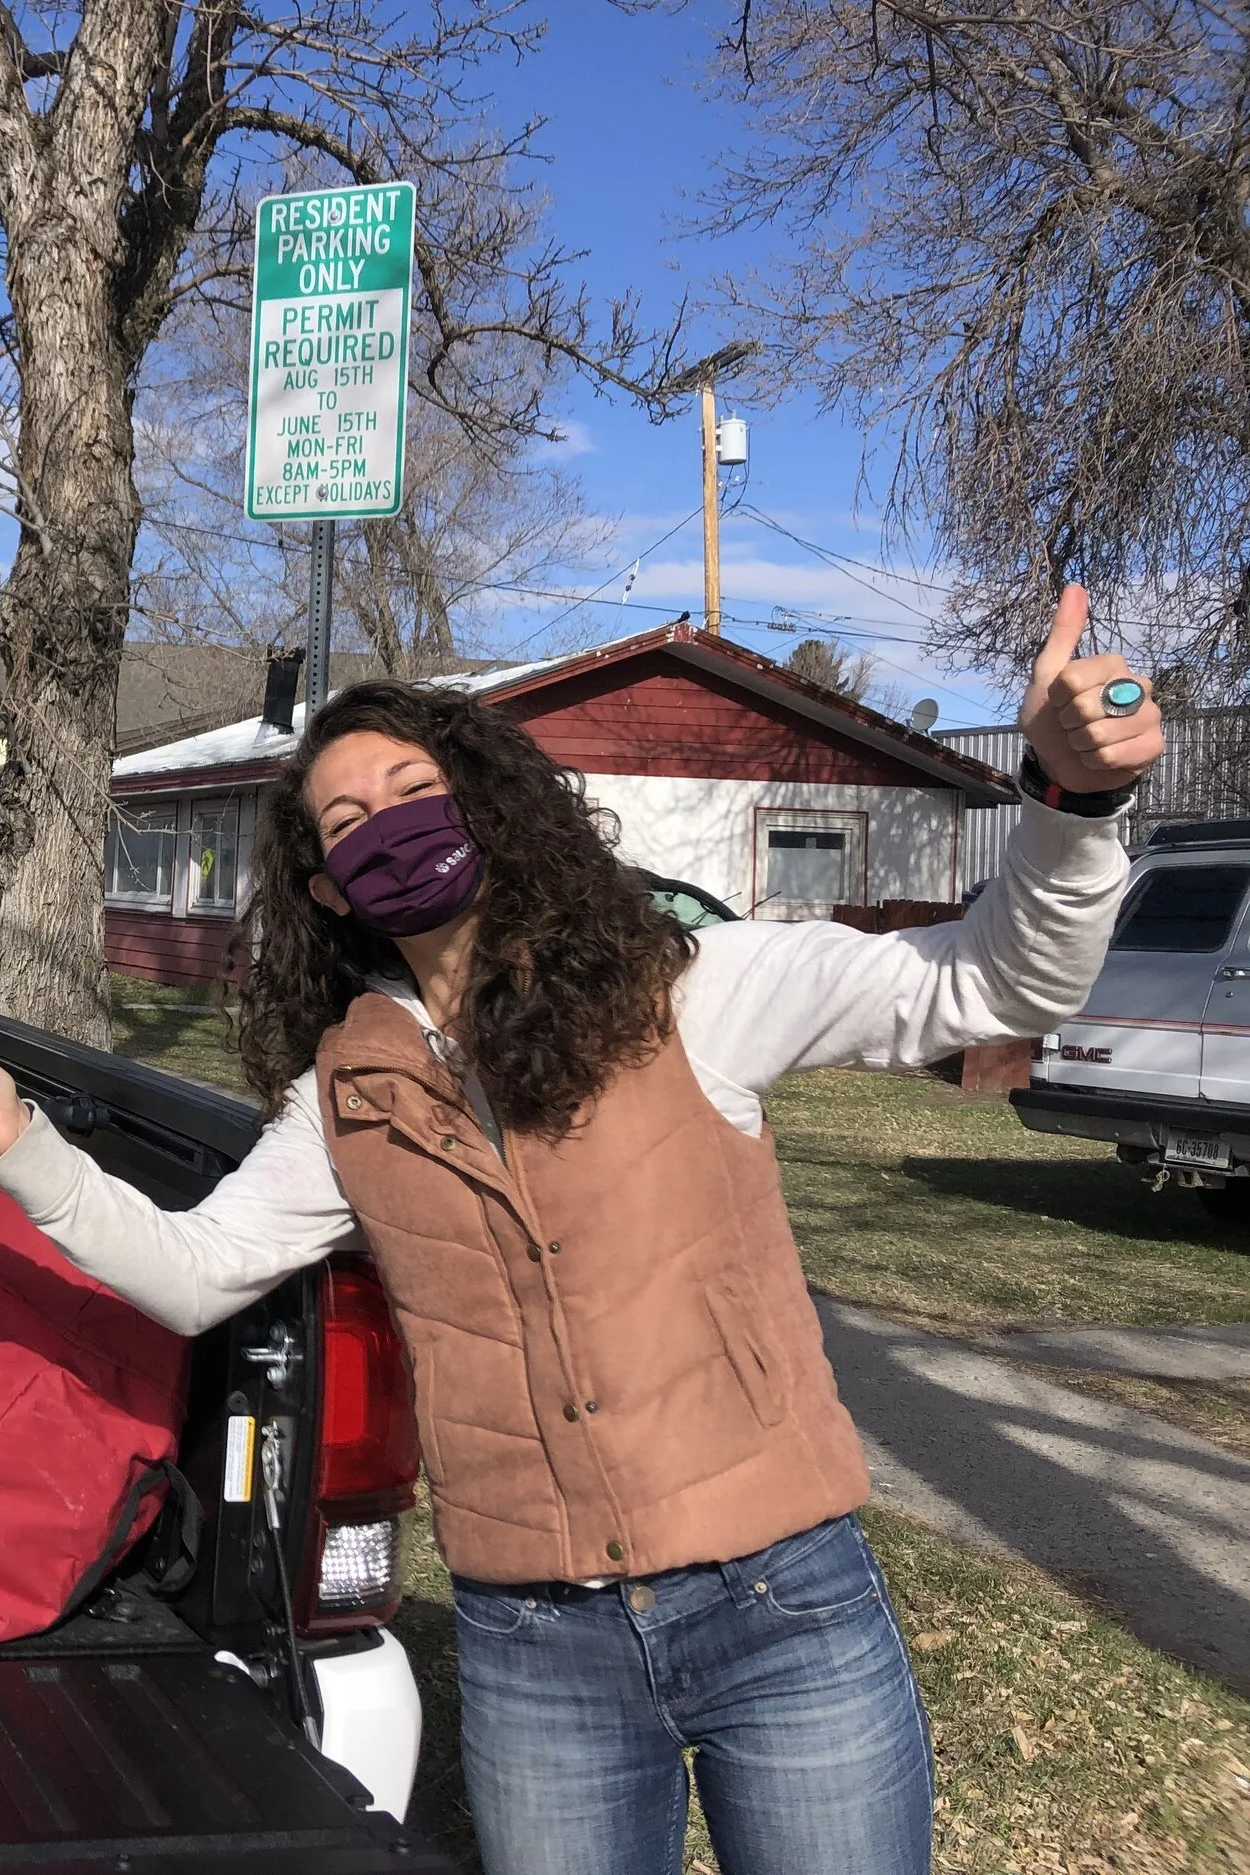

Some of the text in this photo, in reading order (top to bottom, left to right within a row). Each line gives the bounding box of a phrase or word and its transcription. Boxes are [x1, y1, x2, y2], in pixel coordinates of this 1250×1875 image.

[271, 190, 400, 233] RESIDENT
[277, 223, 391, 265] PARKING
[299, 258, 366, 294] ONLY
[282, 299, 380, 335] PERMIT
[264, 331, 395, 369] REQUIRED
[283, 364, 374, 391] AUG 15TH
[316, 391, 338, 411] TO
[276, 411, 378, 437] JUNE 15TH
[286, 435, 364, 459] MON-FRI
[282, 458, 367, 482] 8AM-5PM
[256, 484, 310, 506] EXCEPT
[1061, 1045, 1113, 1065] GMC
